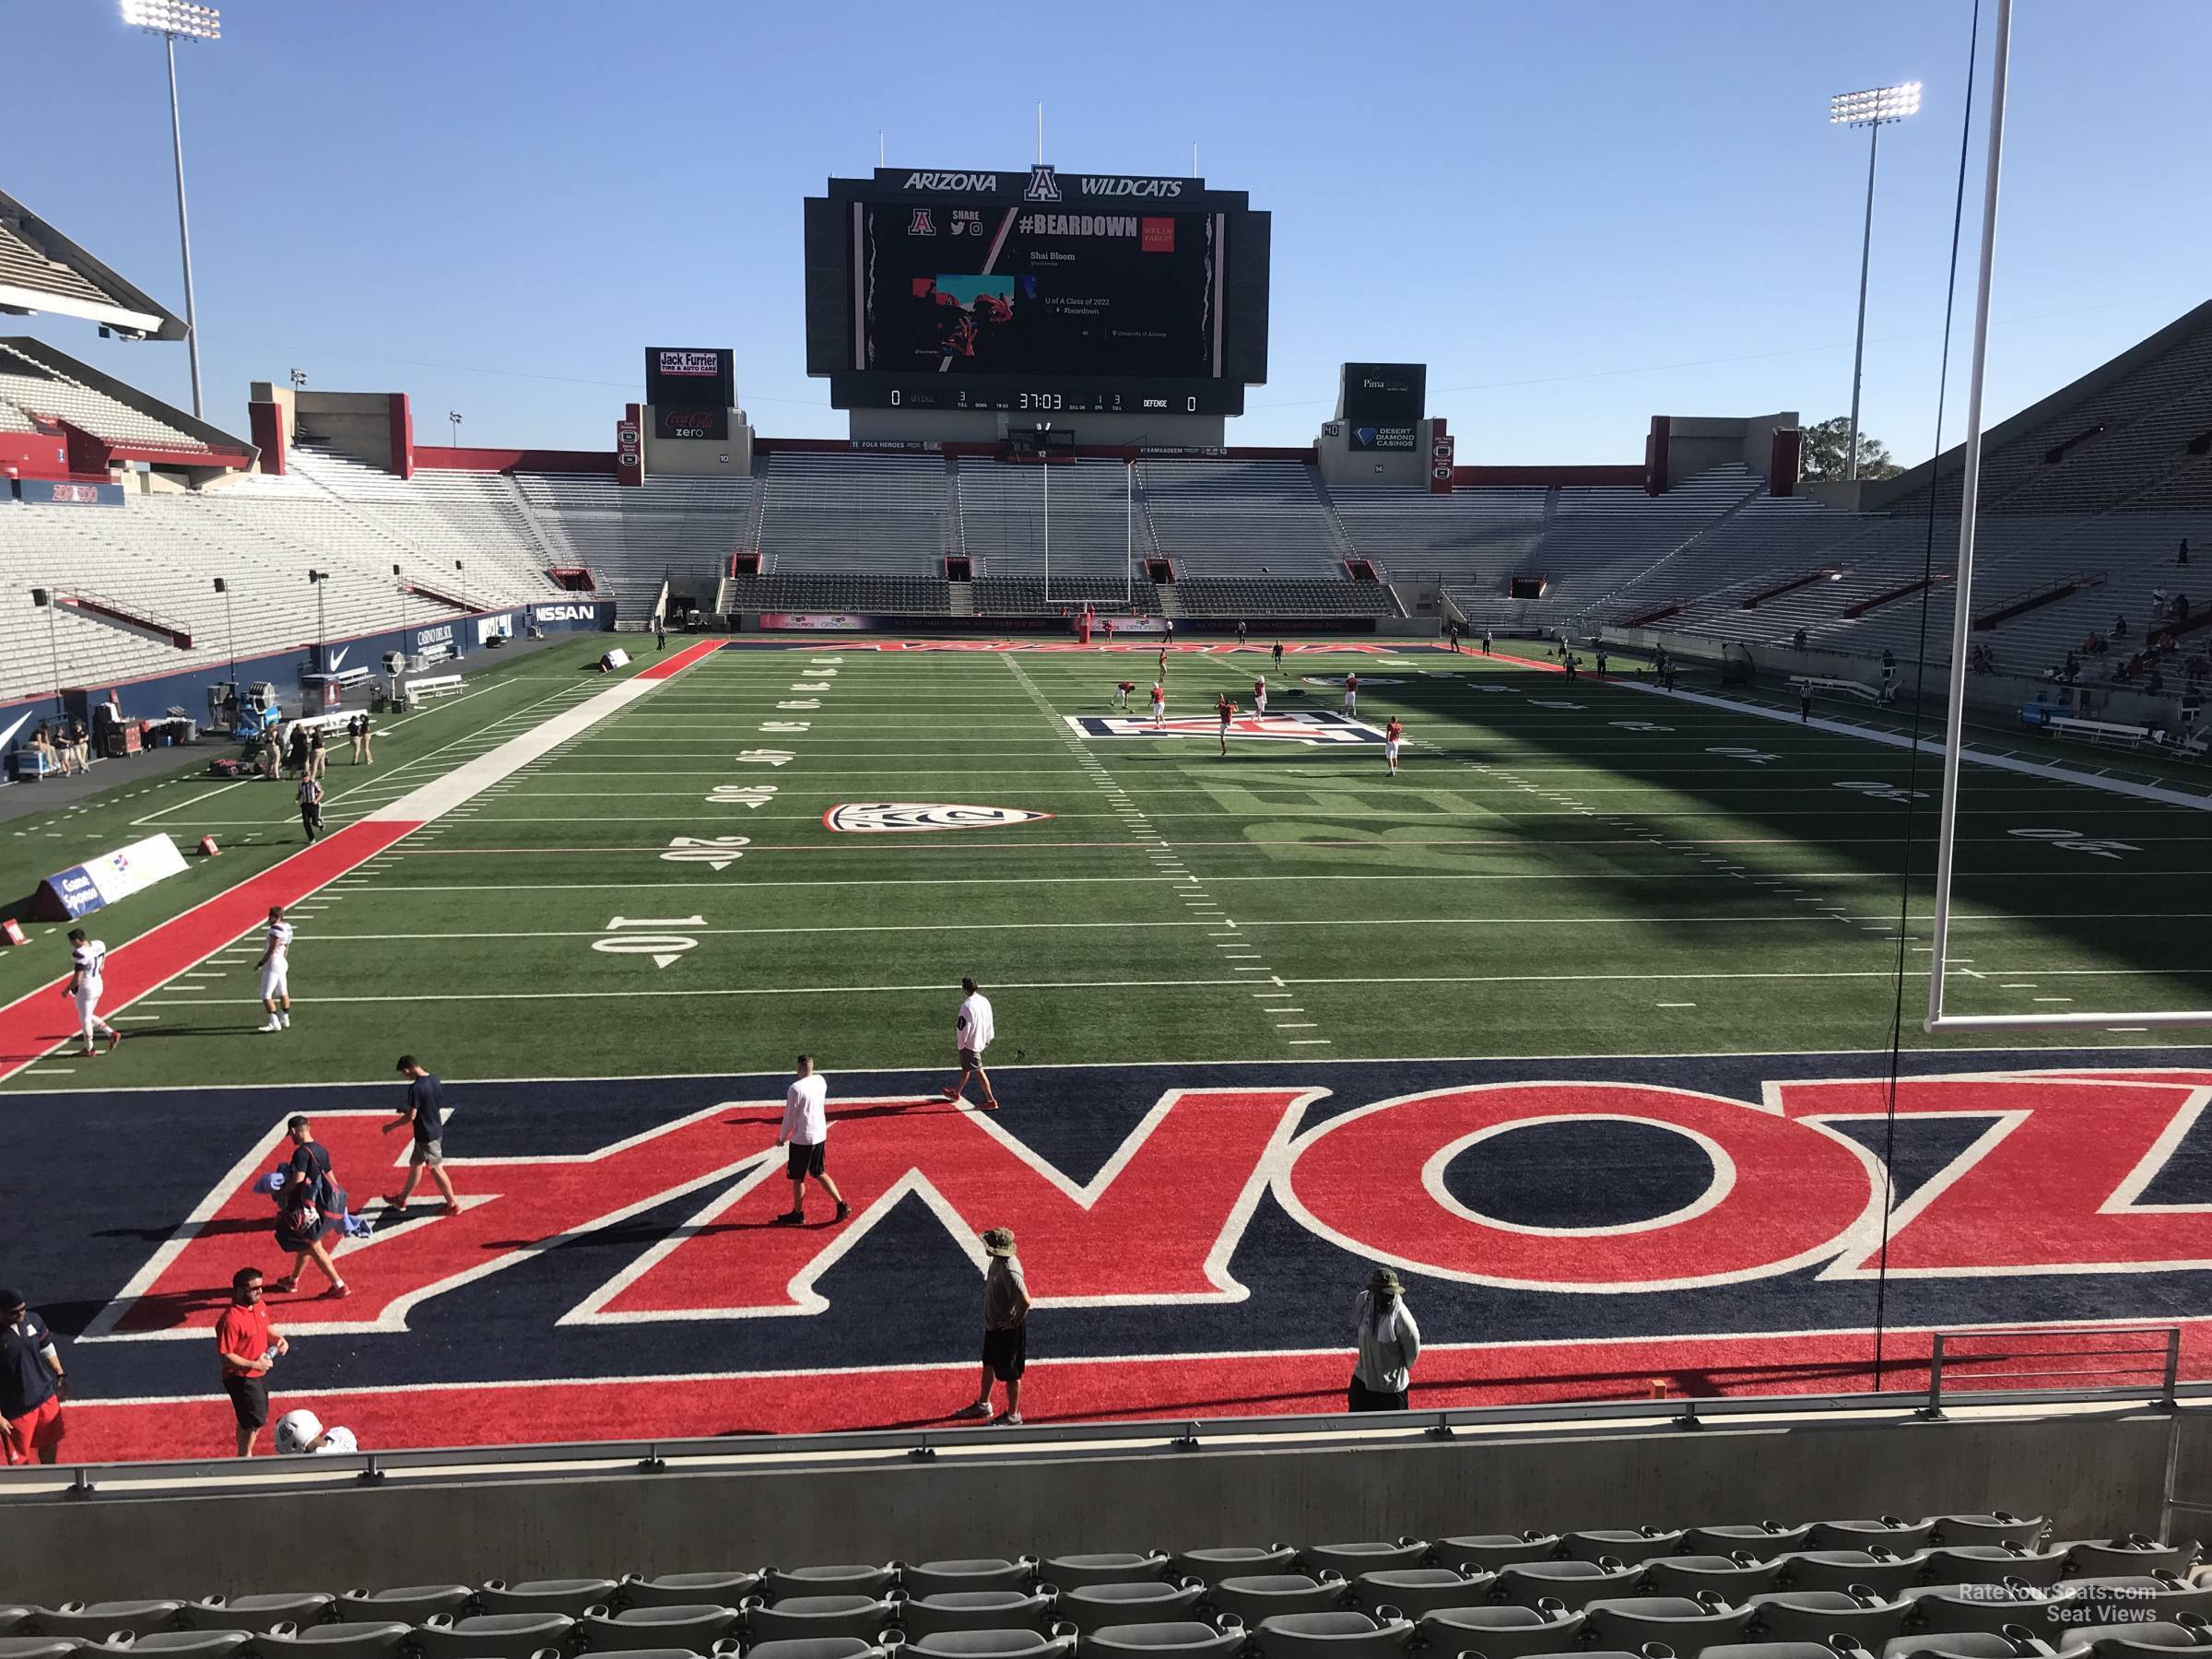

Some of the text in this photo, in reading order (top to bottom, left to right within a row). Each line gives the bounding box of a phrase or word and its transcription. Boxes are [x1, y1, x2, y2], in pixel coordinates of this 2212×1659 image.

[903, 172, 996, 191] ARIZONA
[1082, 178, 1182, 197] WILDCATS
[952, 210, 980, 220] SHARE
[1019, 214, 1137, 237] #BEARDOWN
[1030, 252, 1076, 261] Shai Bloom
[1064, 307, 1100, 315] #beardown
[662, 353, 716, 366] Jack Furrier
[1363, 379, 1384, 388] Pima
[891, 390, 900, 405] 0
[959, 391, 966, 401] 3
[1019, 394, 1062, 409] 37:03
[1187, 397, 1195, 411] 0
[676, 428, 703, 437] zero
[1325, 426, 1338, 435] 40
[536, 606, 594, 622] NISSAN
[418, 629, 436, 646] CASINO
[704, 784, 779, 803] 30
[2007, 829, 2145, 852] 20
[659, 836, 752, 862] 20
[592, 915, 708, 953] 10
[92, 952, 105, 977] 17
